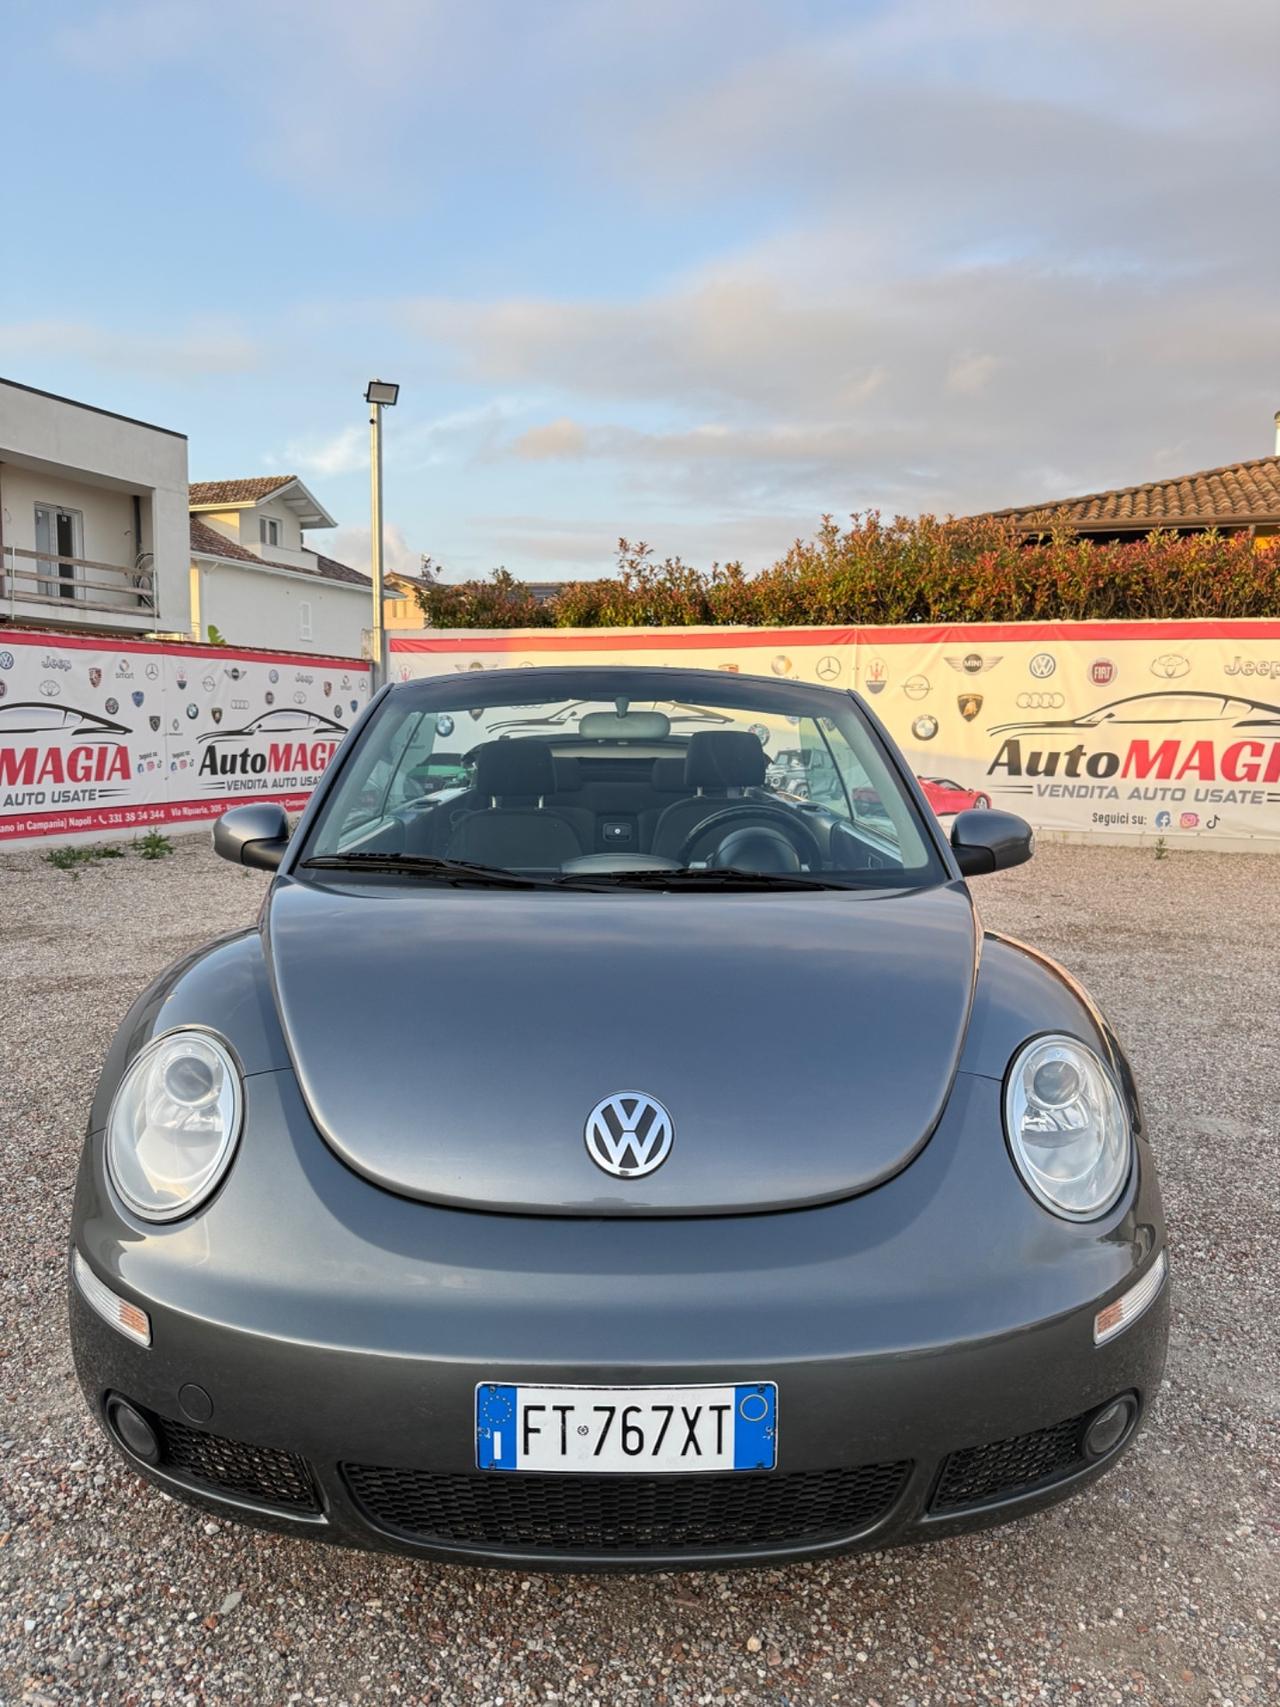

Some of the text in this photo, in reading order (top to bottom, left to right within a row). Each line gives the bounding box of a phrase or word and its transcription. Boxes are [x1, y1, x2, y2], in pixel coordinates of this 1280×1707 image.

[1092, 665, 1113, 682] FIAT
[226, 779, 268, 791] VENDITA
[271, 777, 297, 788] AUTO
[3, 788, 97, 807] AUTO USATE
[1036, 784, 1266, 805] VENDITA AUTO USATE
[1091, 812, 1147, 827] Seguici su:
